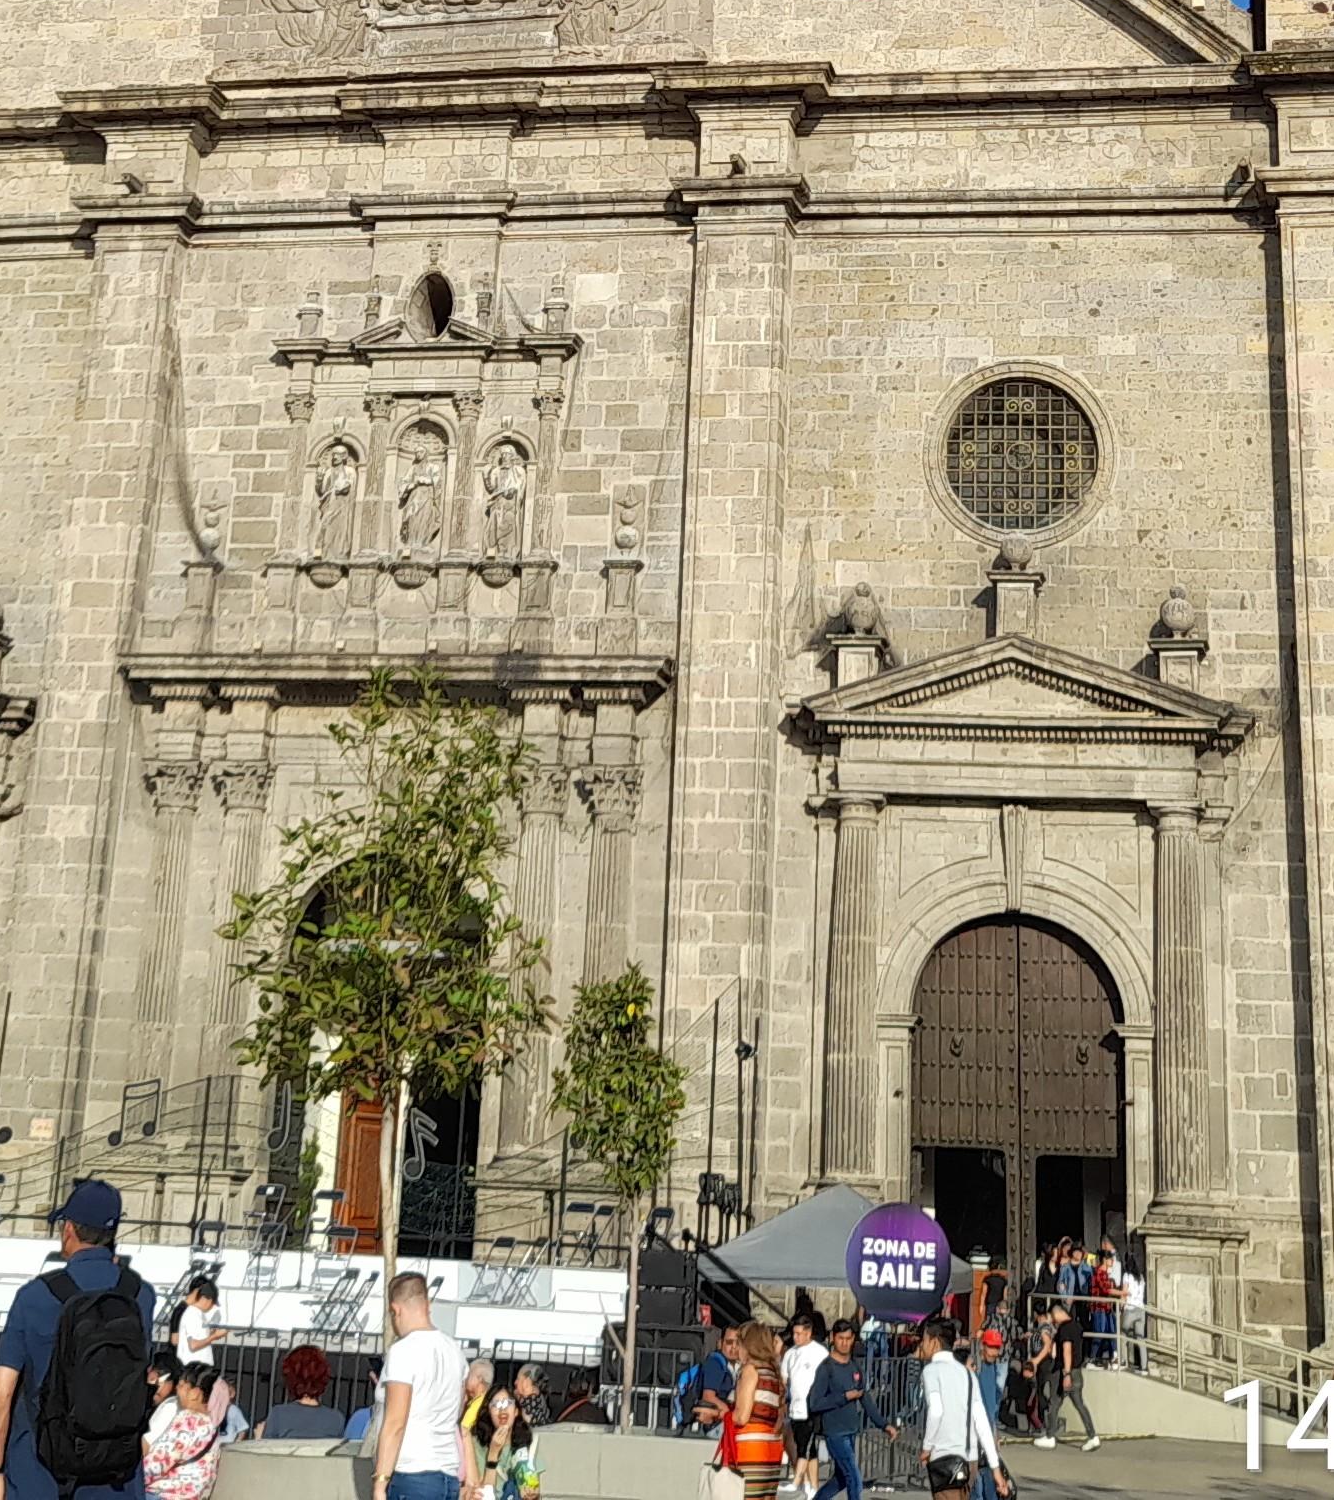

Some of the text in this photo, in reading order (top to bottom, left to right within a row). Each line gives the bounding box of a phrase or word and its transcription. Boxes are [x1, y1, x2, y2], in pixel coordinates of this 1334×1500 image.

[862, 1237, 936, 1260] ZONA DE
[860, 1260, 936, 1291] BAILE
